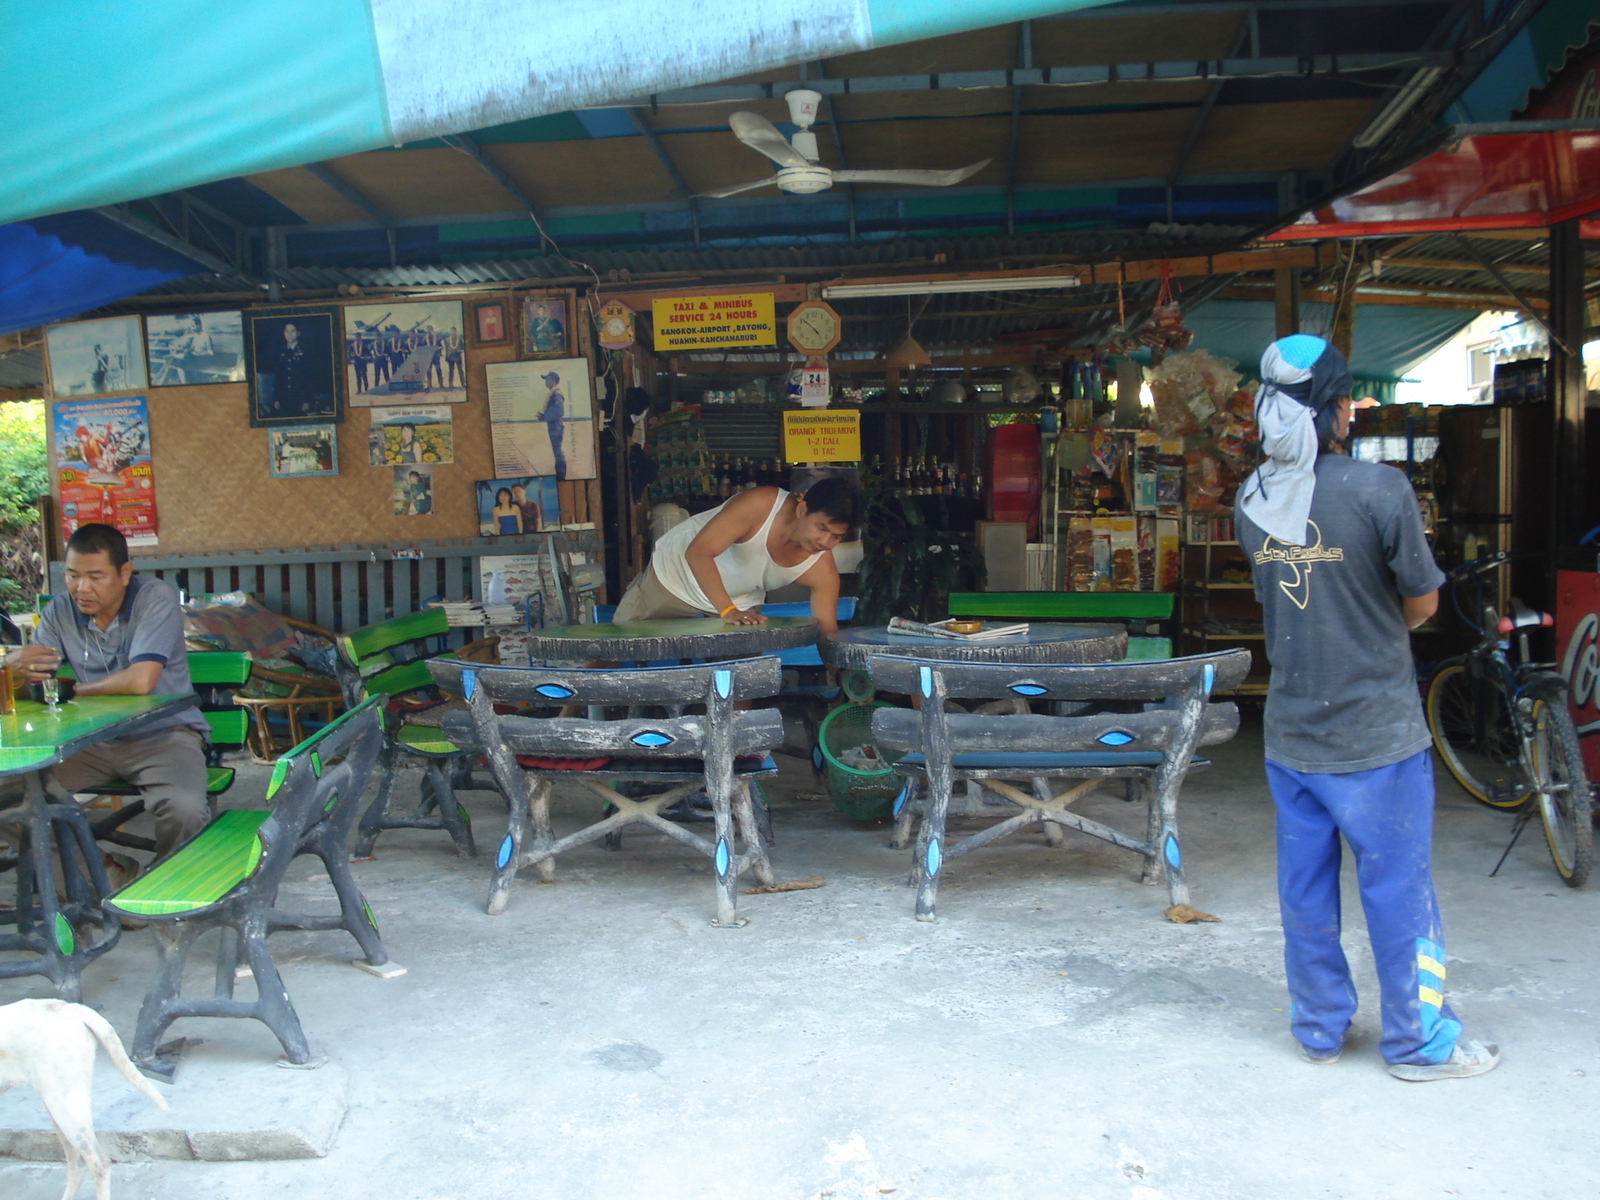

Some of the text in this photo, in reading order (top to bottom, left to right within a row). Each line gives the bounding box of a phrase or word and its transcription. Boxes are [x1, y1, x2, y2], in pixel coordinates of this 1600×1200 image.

[673, 299, 753, 312] TAXI & MINIBUS
[669, 310, 758, 323] SERVICE 24 HOURS
[661, 325, 731, 336] BANGKOK-AIRPORT
[669, 334, 758, 345] HUAHIN-KANCHANABURI
[809, 374, 820, 384] 24
[789, 426, 857, 436] ORANGE TRUEMOVE
[822, 437, 840, 445] CALL
[822, 447, 836, 455] TAC
